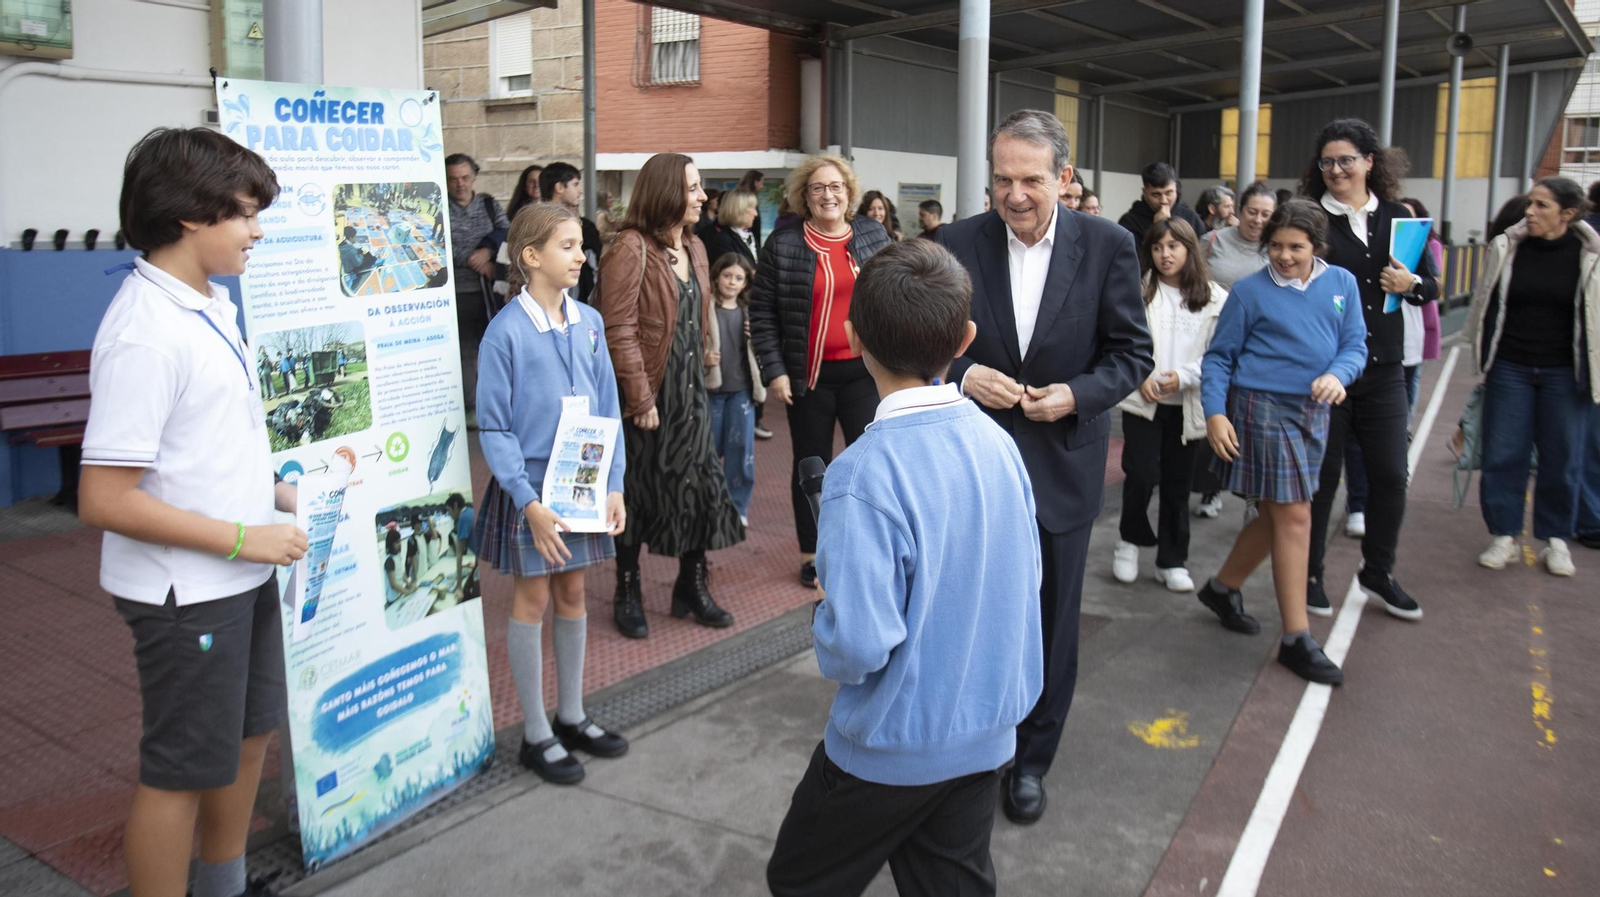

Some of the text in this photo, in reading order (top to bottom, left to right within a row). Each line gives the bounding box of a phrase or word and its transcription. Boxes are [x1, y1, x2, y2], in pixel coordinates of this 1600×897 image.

[275, 91, 384, 124] COÑECER
[246, 125, 414, 152] PARA COIDAR
[384, 154, 420, 163] comprender
[367, 297, 450, 317] DA OBSERVACIÓN
[398, 313, 432, 326] ACCIÓN
[320, 690, 352, 714] CANTO
[354, 678, 376, 697] MÁIS
[377, 654, 428, 686] COÑECEMOS
[429, 650, 436, 660] O
[337, 662, 448, 722] MÁIS RAZÓNS TEMOS PARA
[376, 692, 414, 718] COIDALO
